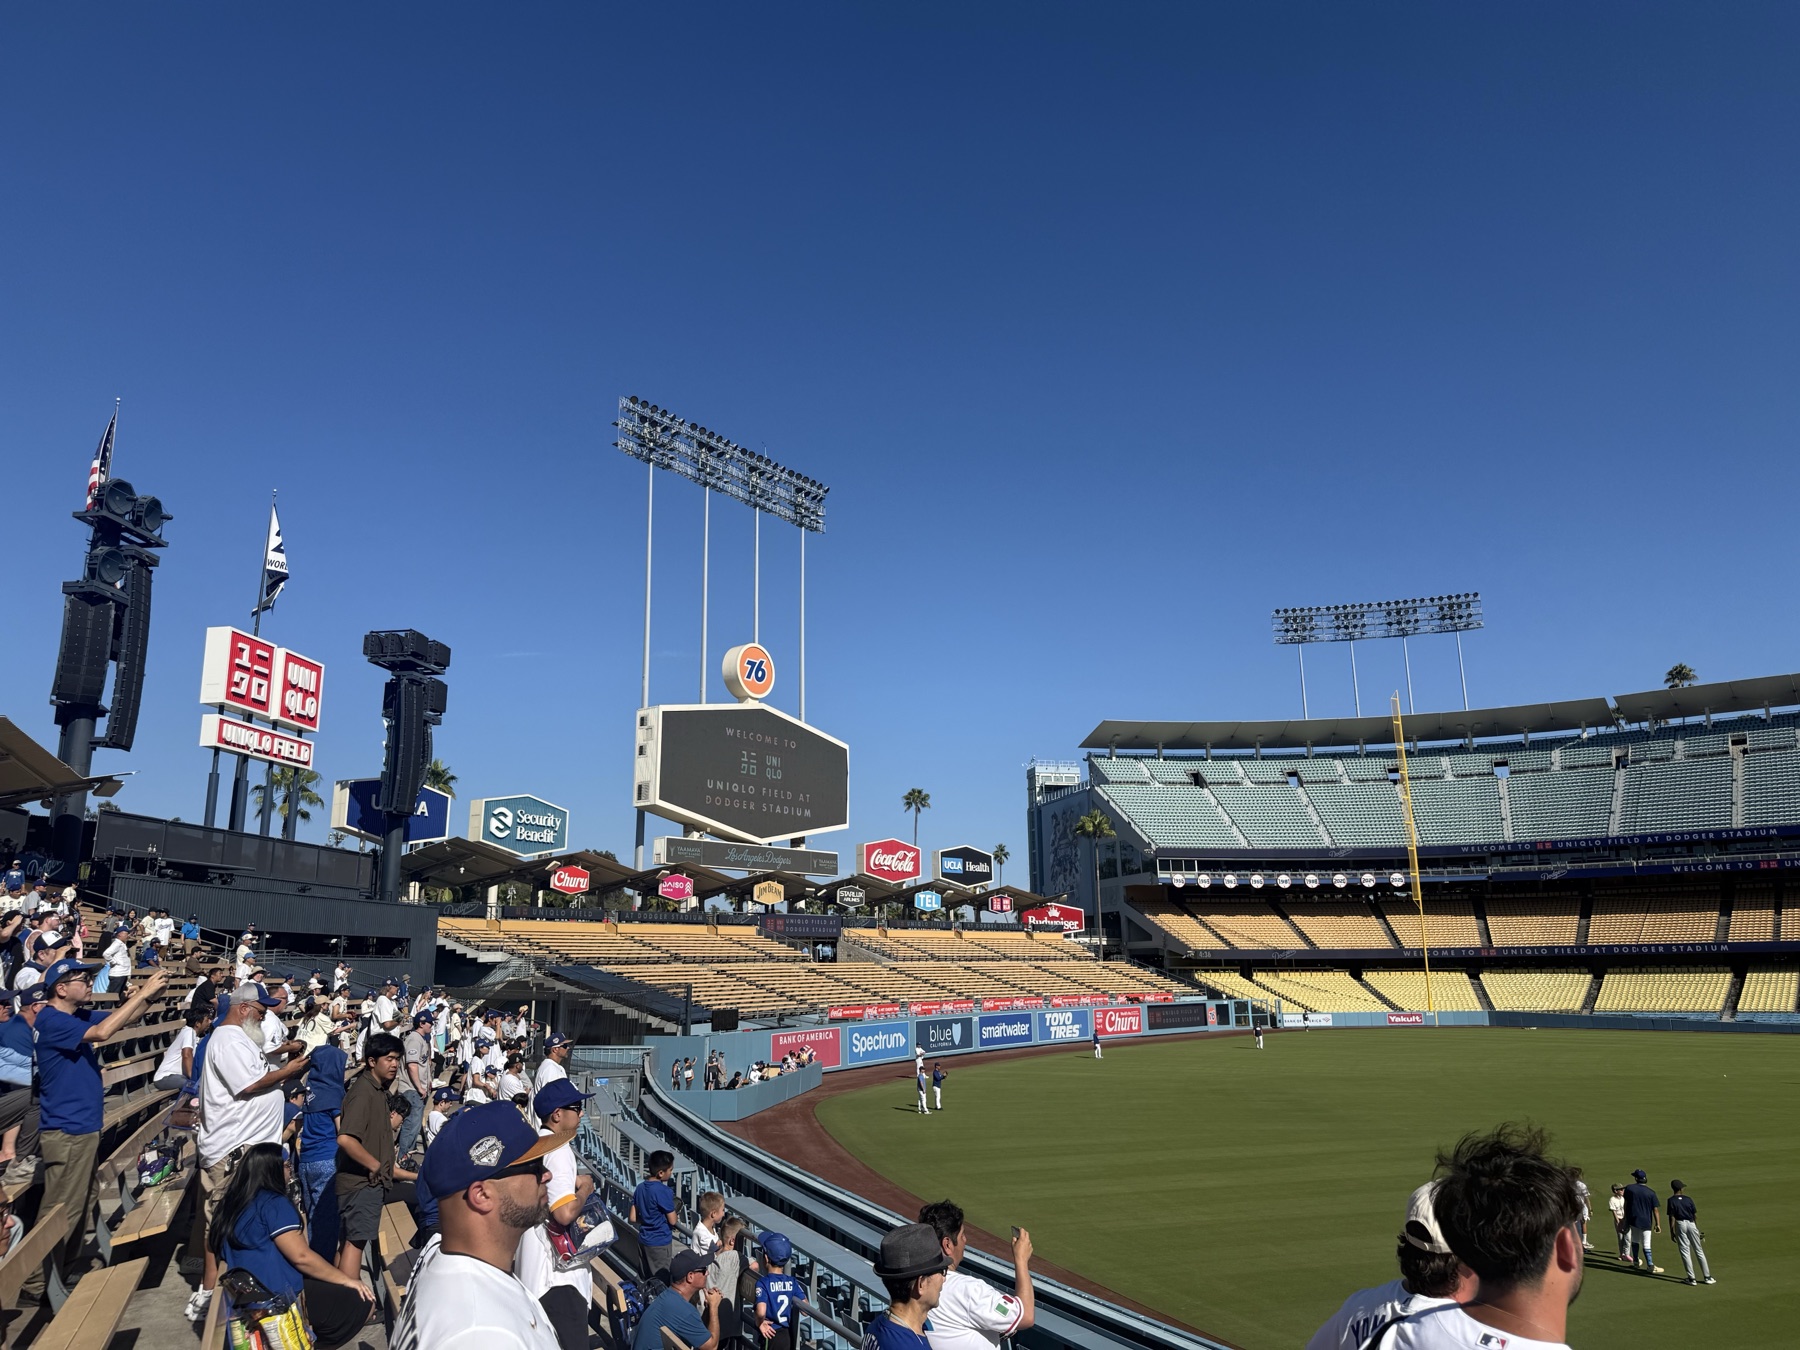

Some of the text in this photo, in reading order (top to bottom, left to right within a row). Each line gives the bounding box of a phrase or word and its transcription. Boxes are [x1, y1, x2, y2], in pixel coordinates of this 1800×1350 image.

[235, 642, 269, 674] ユニ
[287, 662, 317, 693] UNI
[744, 658, 767, 683] 76
[230, 670, 269, 702] クロ
[285, 689, 317, 718] QLO
[222, 723, 310, 762] UNIQLO FIELD
[725, 727, 797, 749] WELCOME TO
[766, 754, 781, 768] UNI
[765, 767, 782, 780] QLO
[707, 779, 811, 803] UNIQLO FIELD AT
[705, 795, 812, 818] DODGER STADIUM
[516, 809, 562, 831] Security
[515, 825, 558, 844] Benefit
[1461, 844, 1512, 852] WELCOME
[1557, 839, 1601, 848] UNIQLO
[1608, 837, 1640, 845] FIELD
[1666, 832, 1715, 842] DODGER
[1721, 828, 1778, 838] STADIUM
[725, 848, 791, 869] Los Angeles Dodgers
[870, 849, 916, 873] Coca-Cola
[943, 858, 990, 873] UCLA Health
[1672, 863, 1731, 873] WELCOME
[554, 870, 588, 889] Churu
[662, 881, 684, 889] DAISO
[757, 883, 782, 900] JIM BEAM
[839, 890, 864, 899] STARLUX
[918, 894, 938, 908] TEL
[532, 908, 566, 917] UNIQLO
[570, 910, 593, 918] FIELD
[638, 912, 667, 920] DODGER
[671, 913, 703, 921] STADIUM
[1403, 949, 1455, 957] WELCOME
[1672, 944, 1729, 952] STADIUM
[1045, 1012, 1073, 1026] TOYO
[1105, 1011, 1139, 1032] Churu
[1389, 1015, 1421, 1023] Yakult
[779, 1031, 833, 1045] BANK OF AMERICA
[929, 1025, 952, 1042] blue
[981, 1021, 1030, 1039] smartwater
[1050, 1024, 1080, 1039] TIRES
[852, 1032, 902, 1057] Spectrum
[929, 1041, 952, 1049] CALIFORNIA
[777, 1295, 789, 1324] 2
